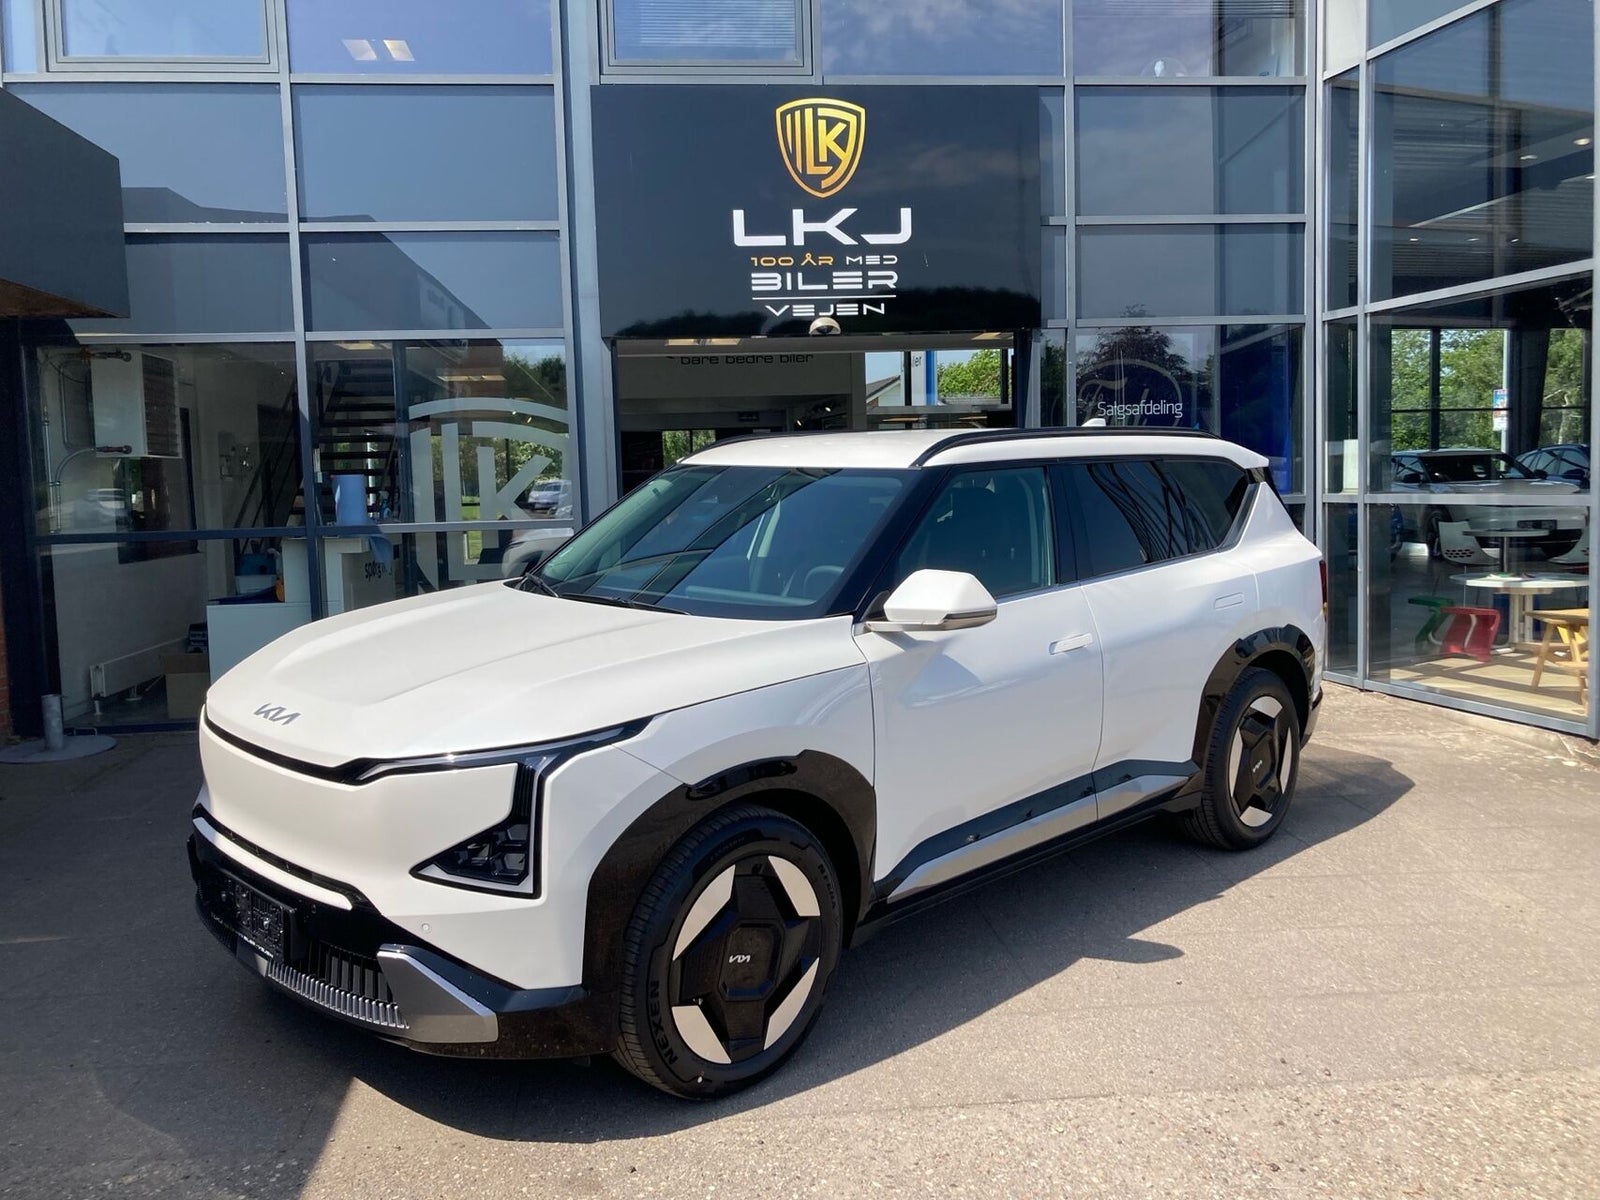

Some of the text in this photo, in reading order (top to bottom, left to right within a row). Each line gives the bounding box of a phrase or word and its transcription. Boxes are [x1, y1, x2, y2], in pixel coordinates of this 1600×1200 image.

[732, 207, 912, 247] LKJ
[750, 252, 898, 267] 100 ÅR MED
[751, 270, 899, 291] BILER
[765, 302, 885, 317] VEJEN
[680, 353, 814, 365] bare bedre biler
[1097, 400, 1184, 420] Salgsafdeling
[253, 702, 302, 726] KIA
[649, 980, 679, 1065] NEXEN
